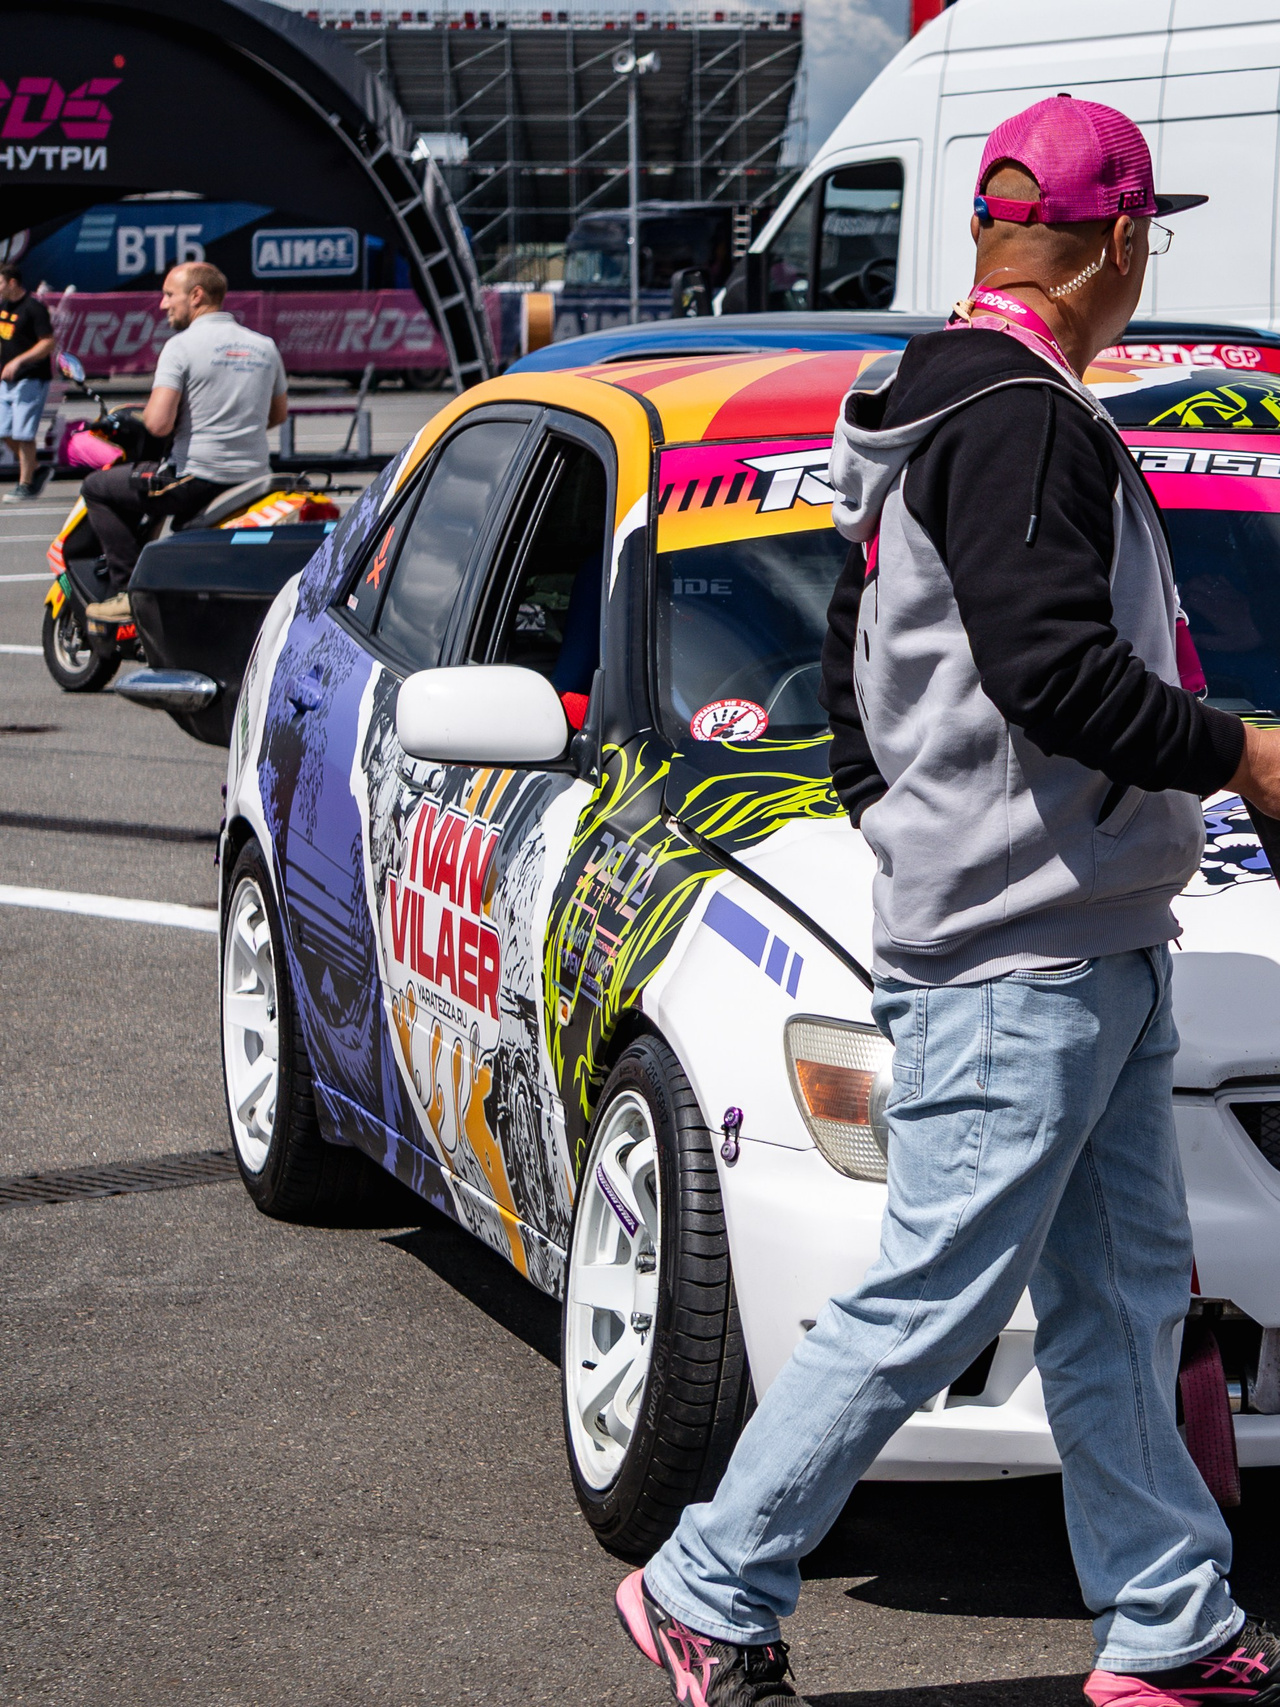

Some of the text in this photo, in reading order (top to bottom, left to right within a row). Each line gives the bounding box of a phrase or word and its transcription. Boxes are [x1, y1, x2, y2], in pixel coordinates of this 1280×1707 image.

[0, 76, 124, 139] DS
[258, 239, 353, 268] AIMOL
[981, 292, 1028, 315] RDS GP
[338, 308, 436, 352] RDS
[1221, 345, 1261, 368] GP
[409, 802, 499, 917] IVAN
[583, 831, 661, 906] DELTA
[389, 877, 501, 1022] VILAER
[416, 982, 468, 1029] YARATEZZA.RU
